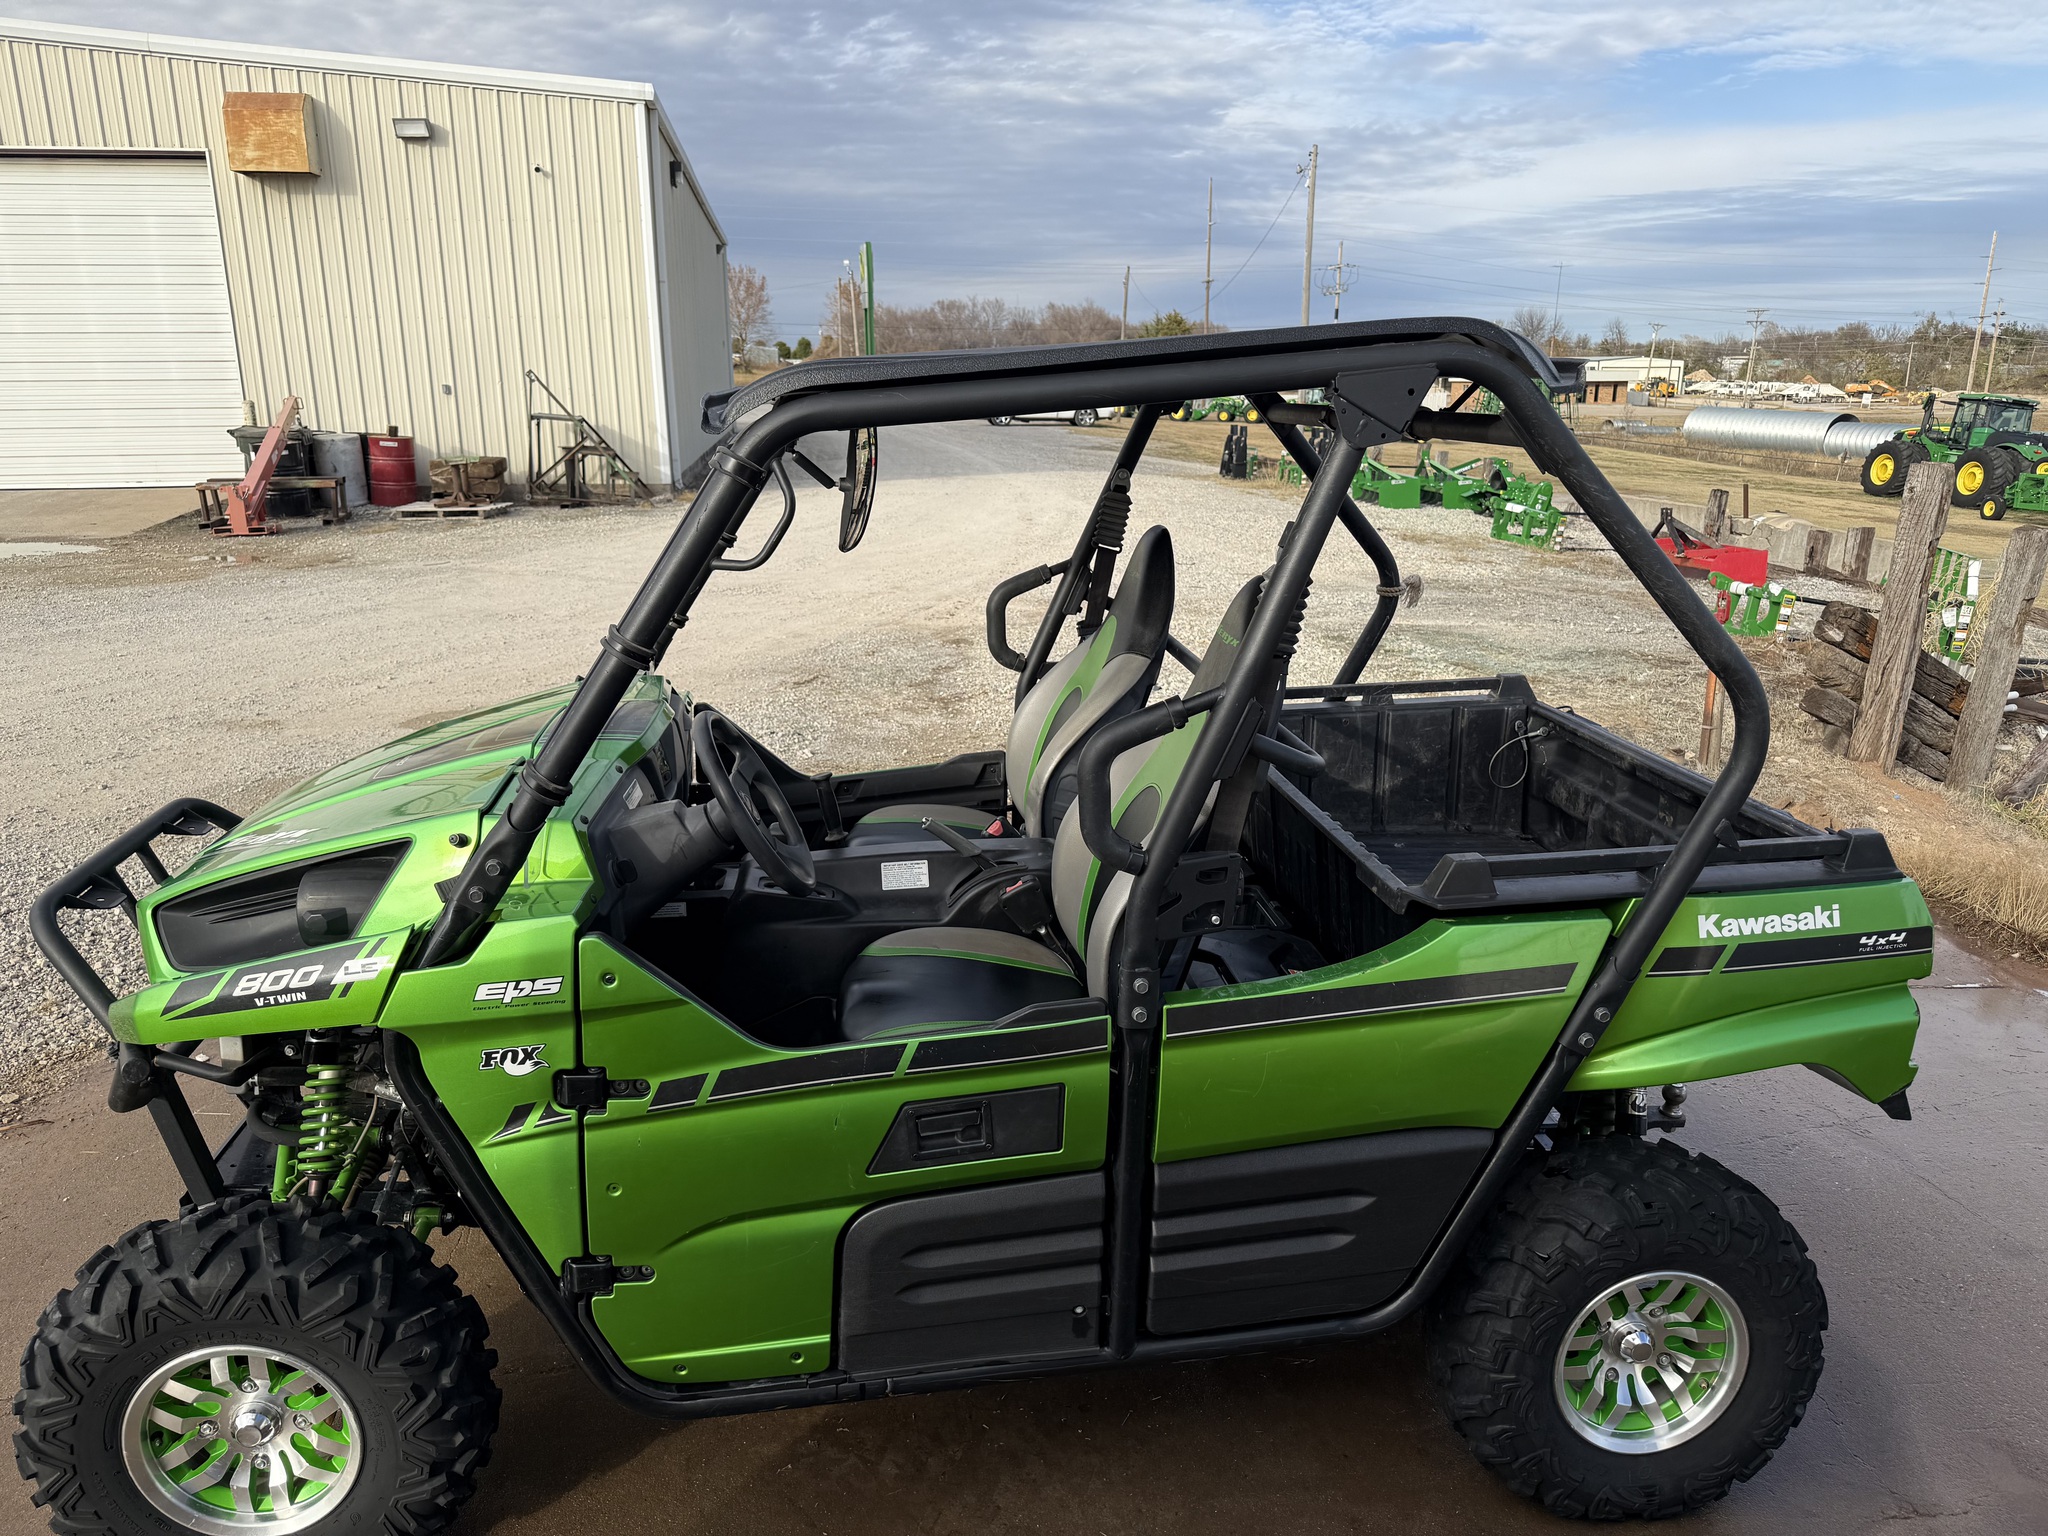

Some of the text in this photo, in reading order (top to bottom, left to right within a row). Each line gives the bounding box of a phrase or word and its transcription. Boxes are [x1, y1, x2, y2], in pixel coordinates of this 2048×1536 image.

[1698, 904, 1840, 939] Kawasaki
[1859, 932, 1907, 946] 4x4
[1876, 943, 1908, 951] INJECTION
[343, 962, 379, 976] LE
[232, 964, 325, 997] 800
[254, 991, 307, 1007] V-TWIN
[480, 1044, 545, 1069] FOX
